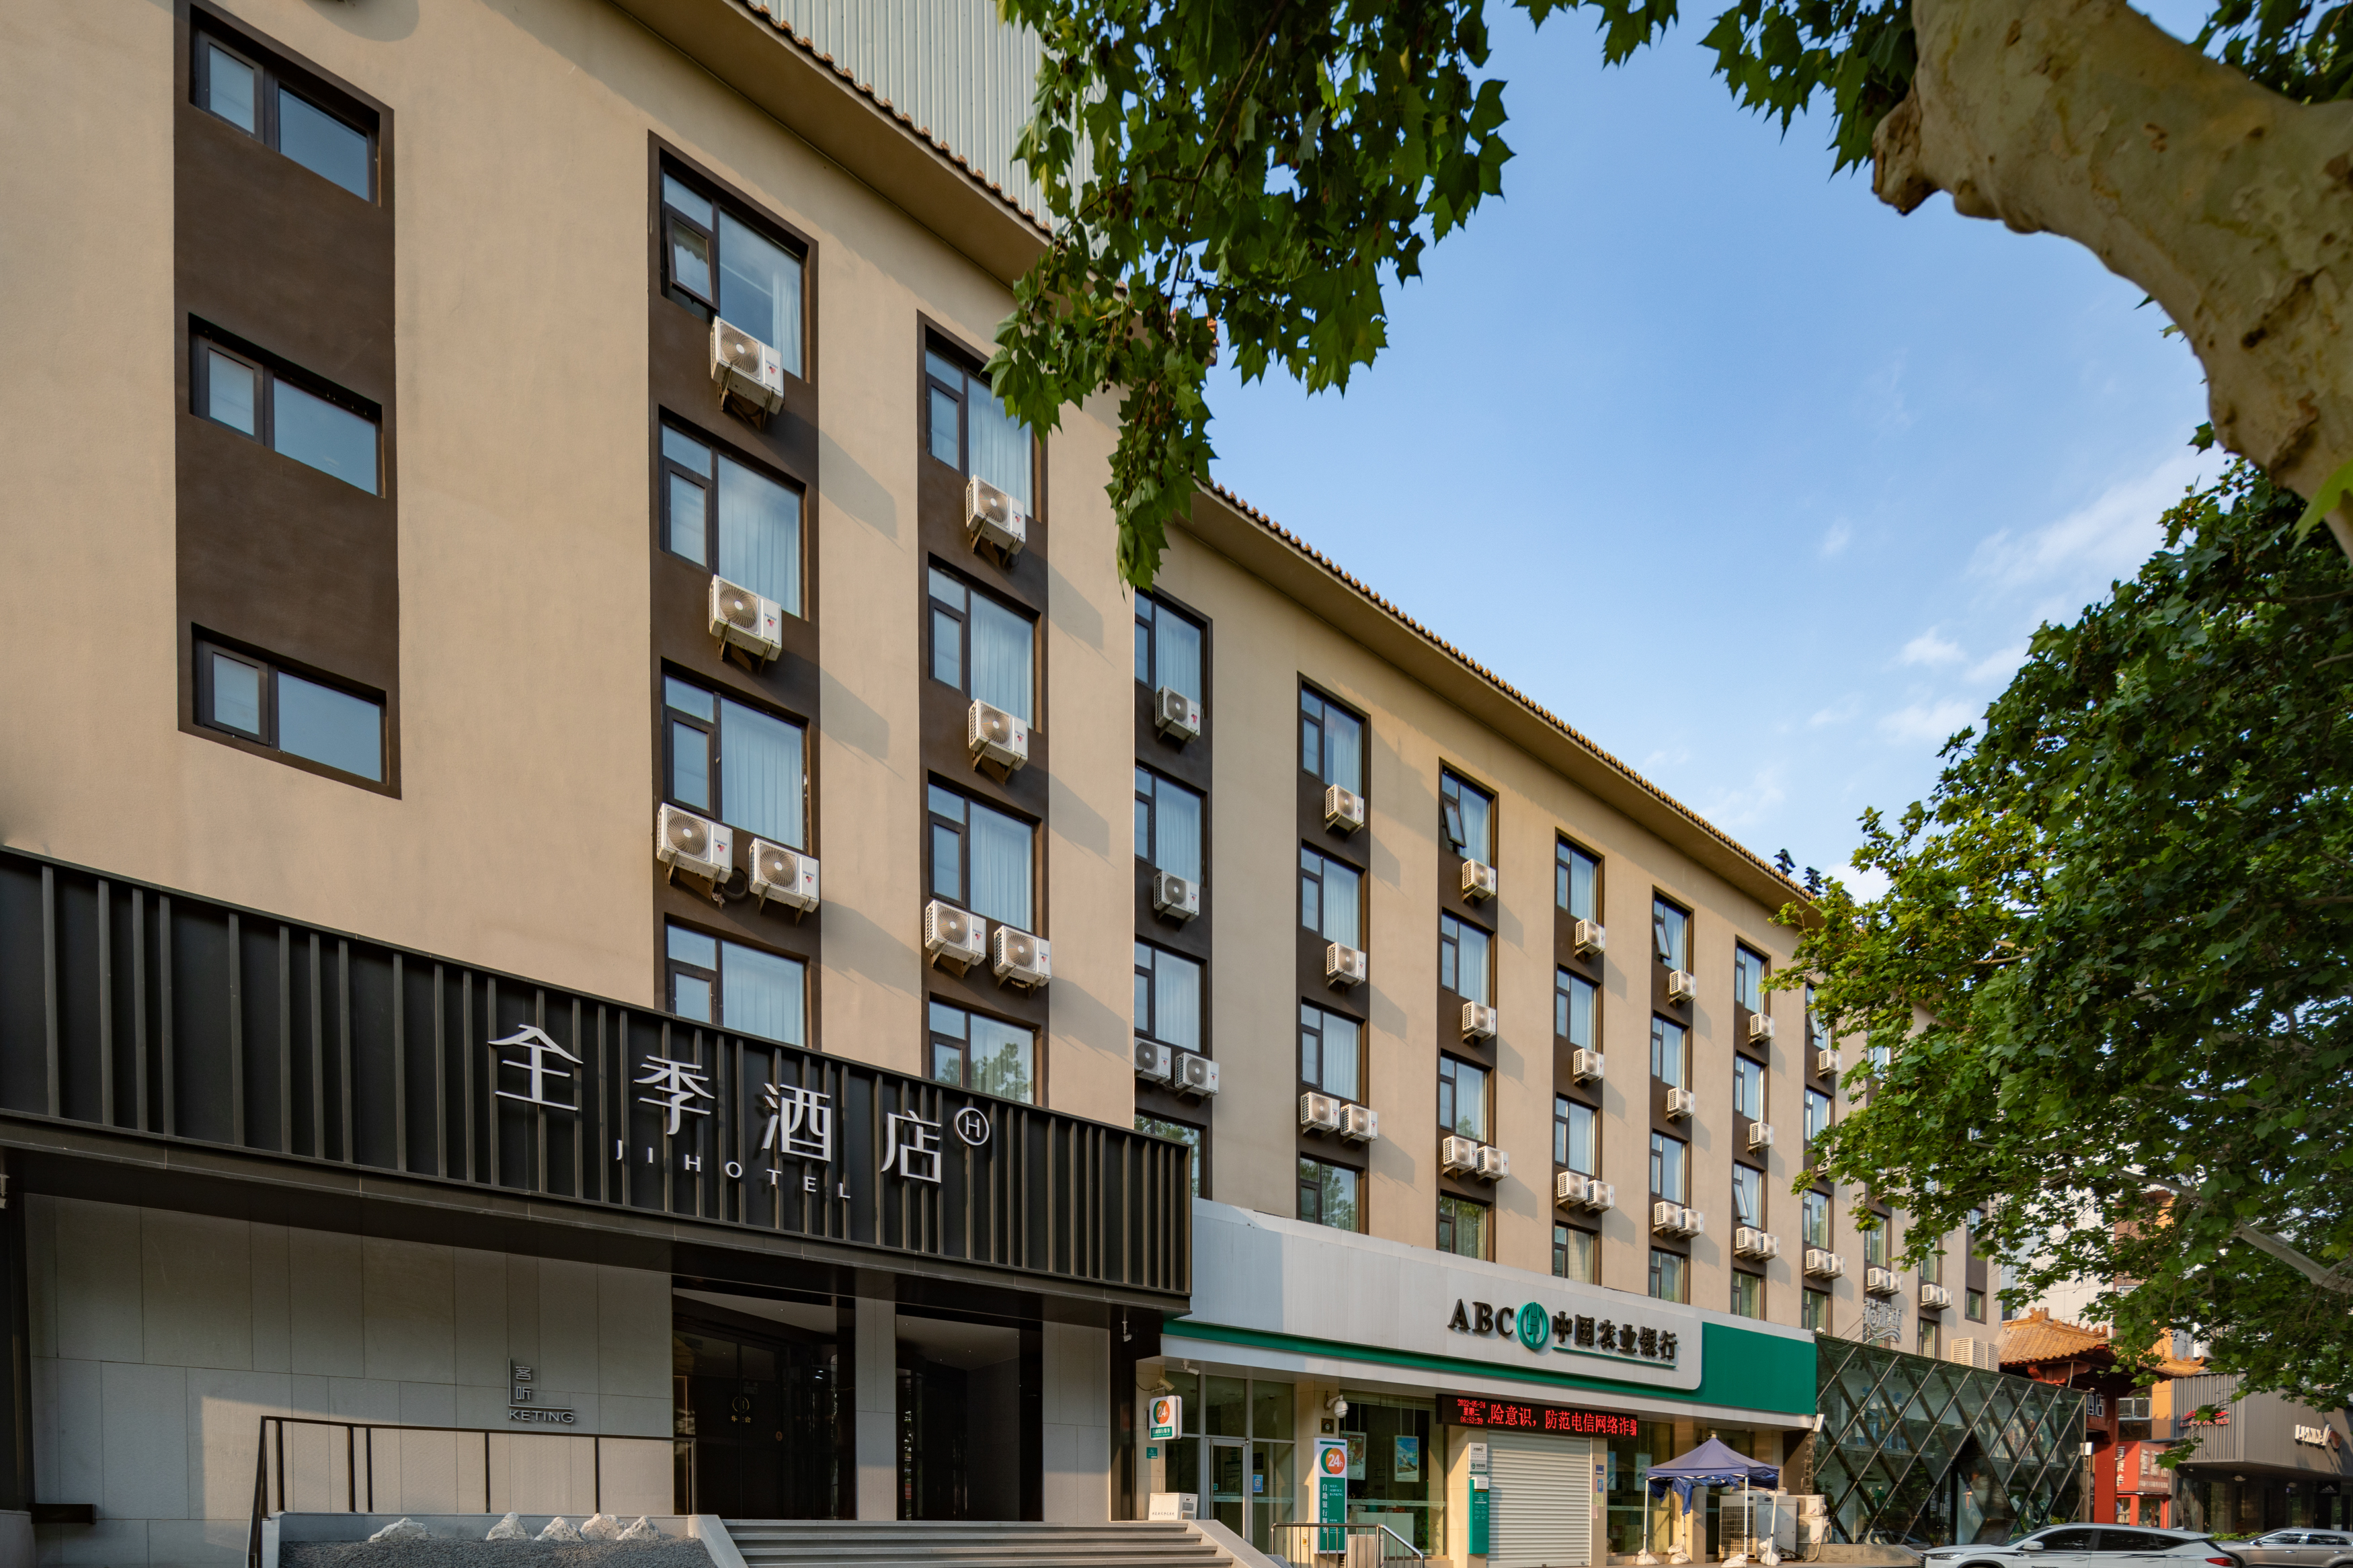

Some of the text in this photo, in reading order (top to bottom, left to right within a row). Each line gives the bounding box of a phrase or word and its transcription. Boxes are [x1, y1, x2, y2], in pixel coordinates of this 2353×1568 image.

[715, 838, 727, 846] Haier
[803, 870, 815, 878] Haier
[488, 1024, 941, 1183] 全季酒店
[1447, 1298, 1514, 1336] ABC
[1552, 1311, 1678, 1360] 中国农业银行
[1457, 1399, 1486, 1408] 2022-05-24
[509, 1409, 574, 1423] KETING
[1158, 1406, 1168, 1418] 24h
[1463, 1407, 1480, 1416] 星期二
[1460, 1416, 1483, 1425] 06:52:39
[1328, 1454, 1343, 1467] 24h
